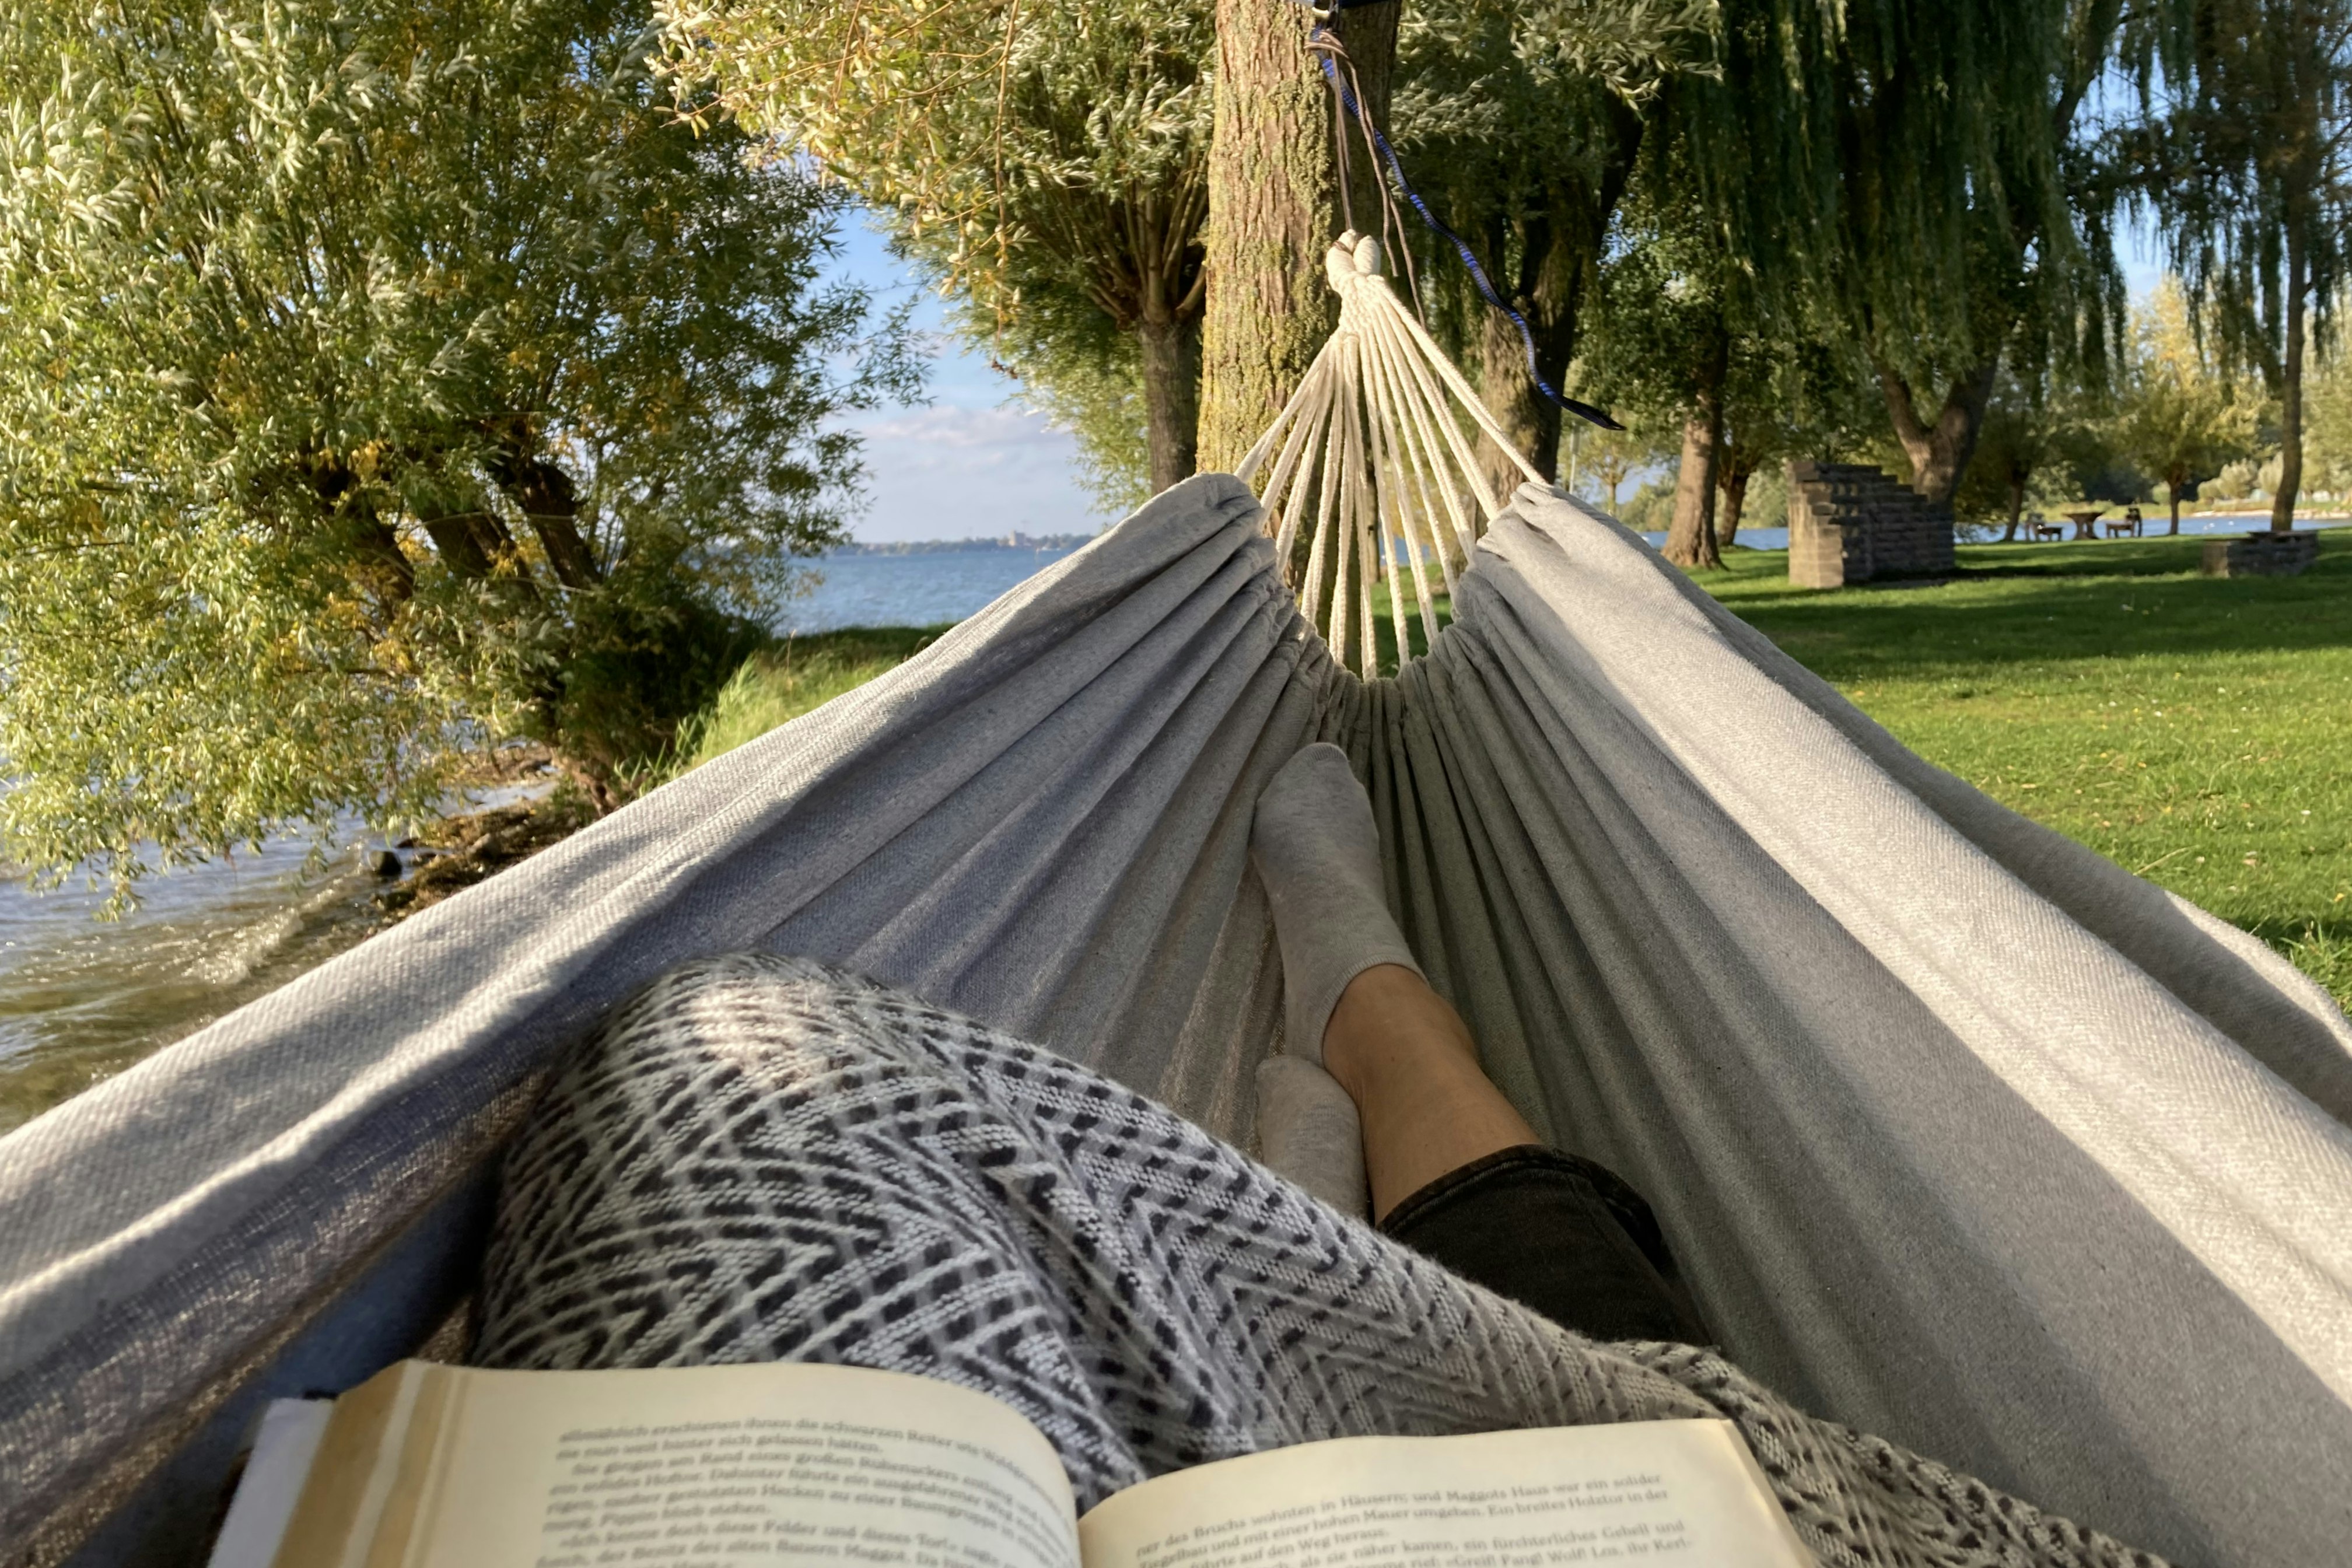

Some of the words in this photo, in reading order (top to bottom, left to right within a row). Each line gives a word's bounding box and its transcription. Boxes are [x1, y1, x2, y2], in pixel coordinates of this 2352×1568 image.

[718, 1434, 752, 1448] sich
[755, 1433, 823, 1448] gelassen
[794, 1418, 818, 1430] die
[822, 1421, 904, 1439] schwarzen
[907, 1429, 953, 1447] Reiter
[794, 1452, 854, 1467] großen
[1136, 1541, 1160, 1559] ner
[1165, 1533, 1189, 1548] des
[1194, 1518, 1247, 1539] Bruchs
[1251, 1504, 1315, 1526] wohnten
[1320, 1499, 1336, 1513] in
[1412, 1490, 1441, 1502] und
[1446, 1489, 1507, 1503] Maggots
[1510, 1484, 1550, 1499] Haus
[1553, 1482, 1580, 1492] war
[1585, 1478, 1609, 1491] ein
[1613, 1473, 1661, 1488] solider
[1211, 1534, 1240, 1552] und
[1243, 1530, 1269, 1546] mit
[1272, 1522, 1311, 1539] einer
[1312, 1514, 1360, 1531] hohen
[1363, 1508, 1410, 1522] Mauer
[1412, 1507, 1485, 1520] umgeben.
[1486, 1504, 1514, 1517] Ein
[1515, 1500, 1566, 1514] breites
[1568, 1494, 1623, 1510] Holztor
[1626, 1492, 1643, 1503] in
[1644, 1488, 1669, 1500] der
[1240, 1546, 1264, 1564] auf
[1267, 1543, 1294, 1559] den
[1297, 1535, 1332, 1552] Weg
[1334, 1527, 1391, 1544] heraus.
[1300, 1555, 1321, 1568] als
[1325, 1550, 1347, 1564] sie
[1352, 1543, 1397, 1559] näher
[1402, 1540, 1460, 1553] kamen,
[1463, 1538, 1488, 1552] ein
[1492, 1530, 1598, 1550] fürchterliches
[1601, 1522, 1650, 1541] Gebell
[1655, 1518, 1686, 1535] und
[1627, 1541, 1649, 1556] ihr
